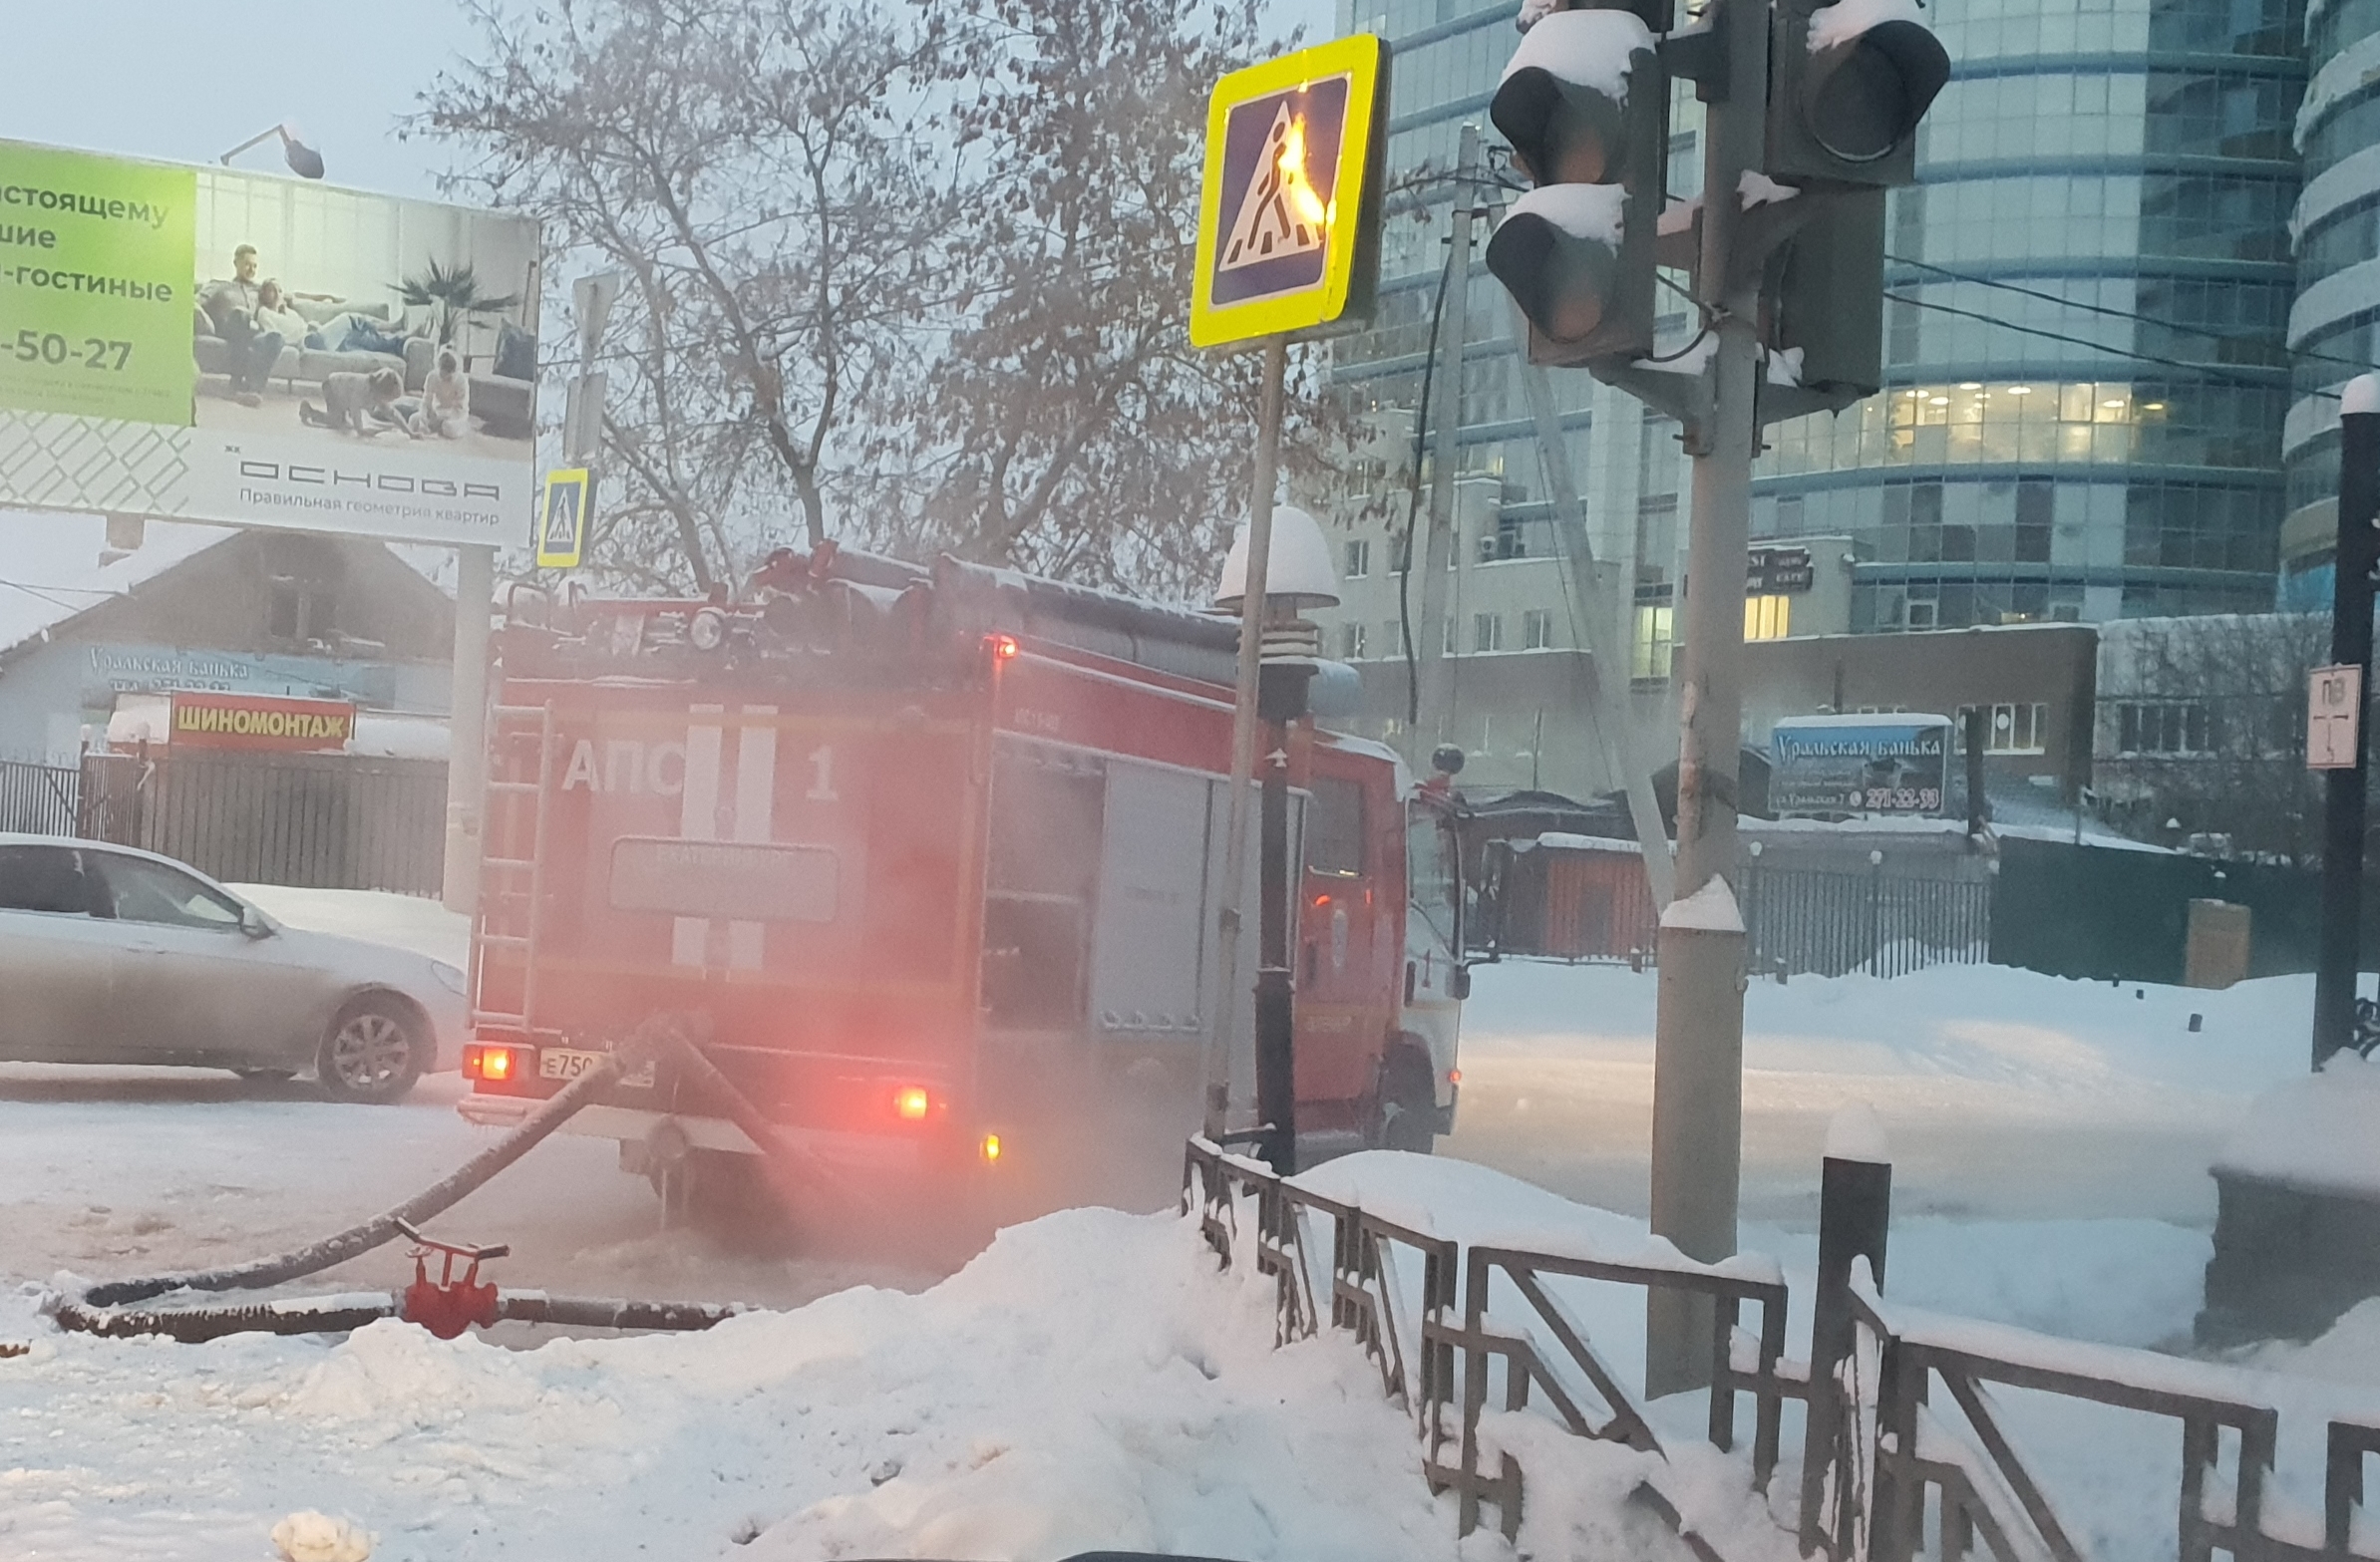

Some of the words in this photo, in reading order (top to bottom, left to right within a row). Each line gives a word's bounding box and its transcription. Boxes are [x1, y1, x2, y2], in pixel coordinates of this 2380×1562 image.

[0, 185, 170, 229] стоящему
[0, 265, 172, 302] -гостиные
[1, 329, 133, 371] -50-27
[240, 461, 500, 501] ОСНОВА
[240, 487, 342, 510] Правильная
[346, 499, 432, 517] геометрия
[436, 507, 500, 526] квартир
[177, 706, 345, 739] ШИНОМОНТАЖ
[561, 739, 686, 795] АПС
[806, 745, 839, 800] 1
